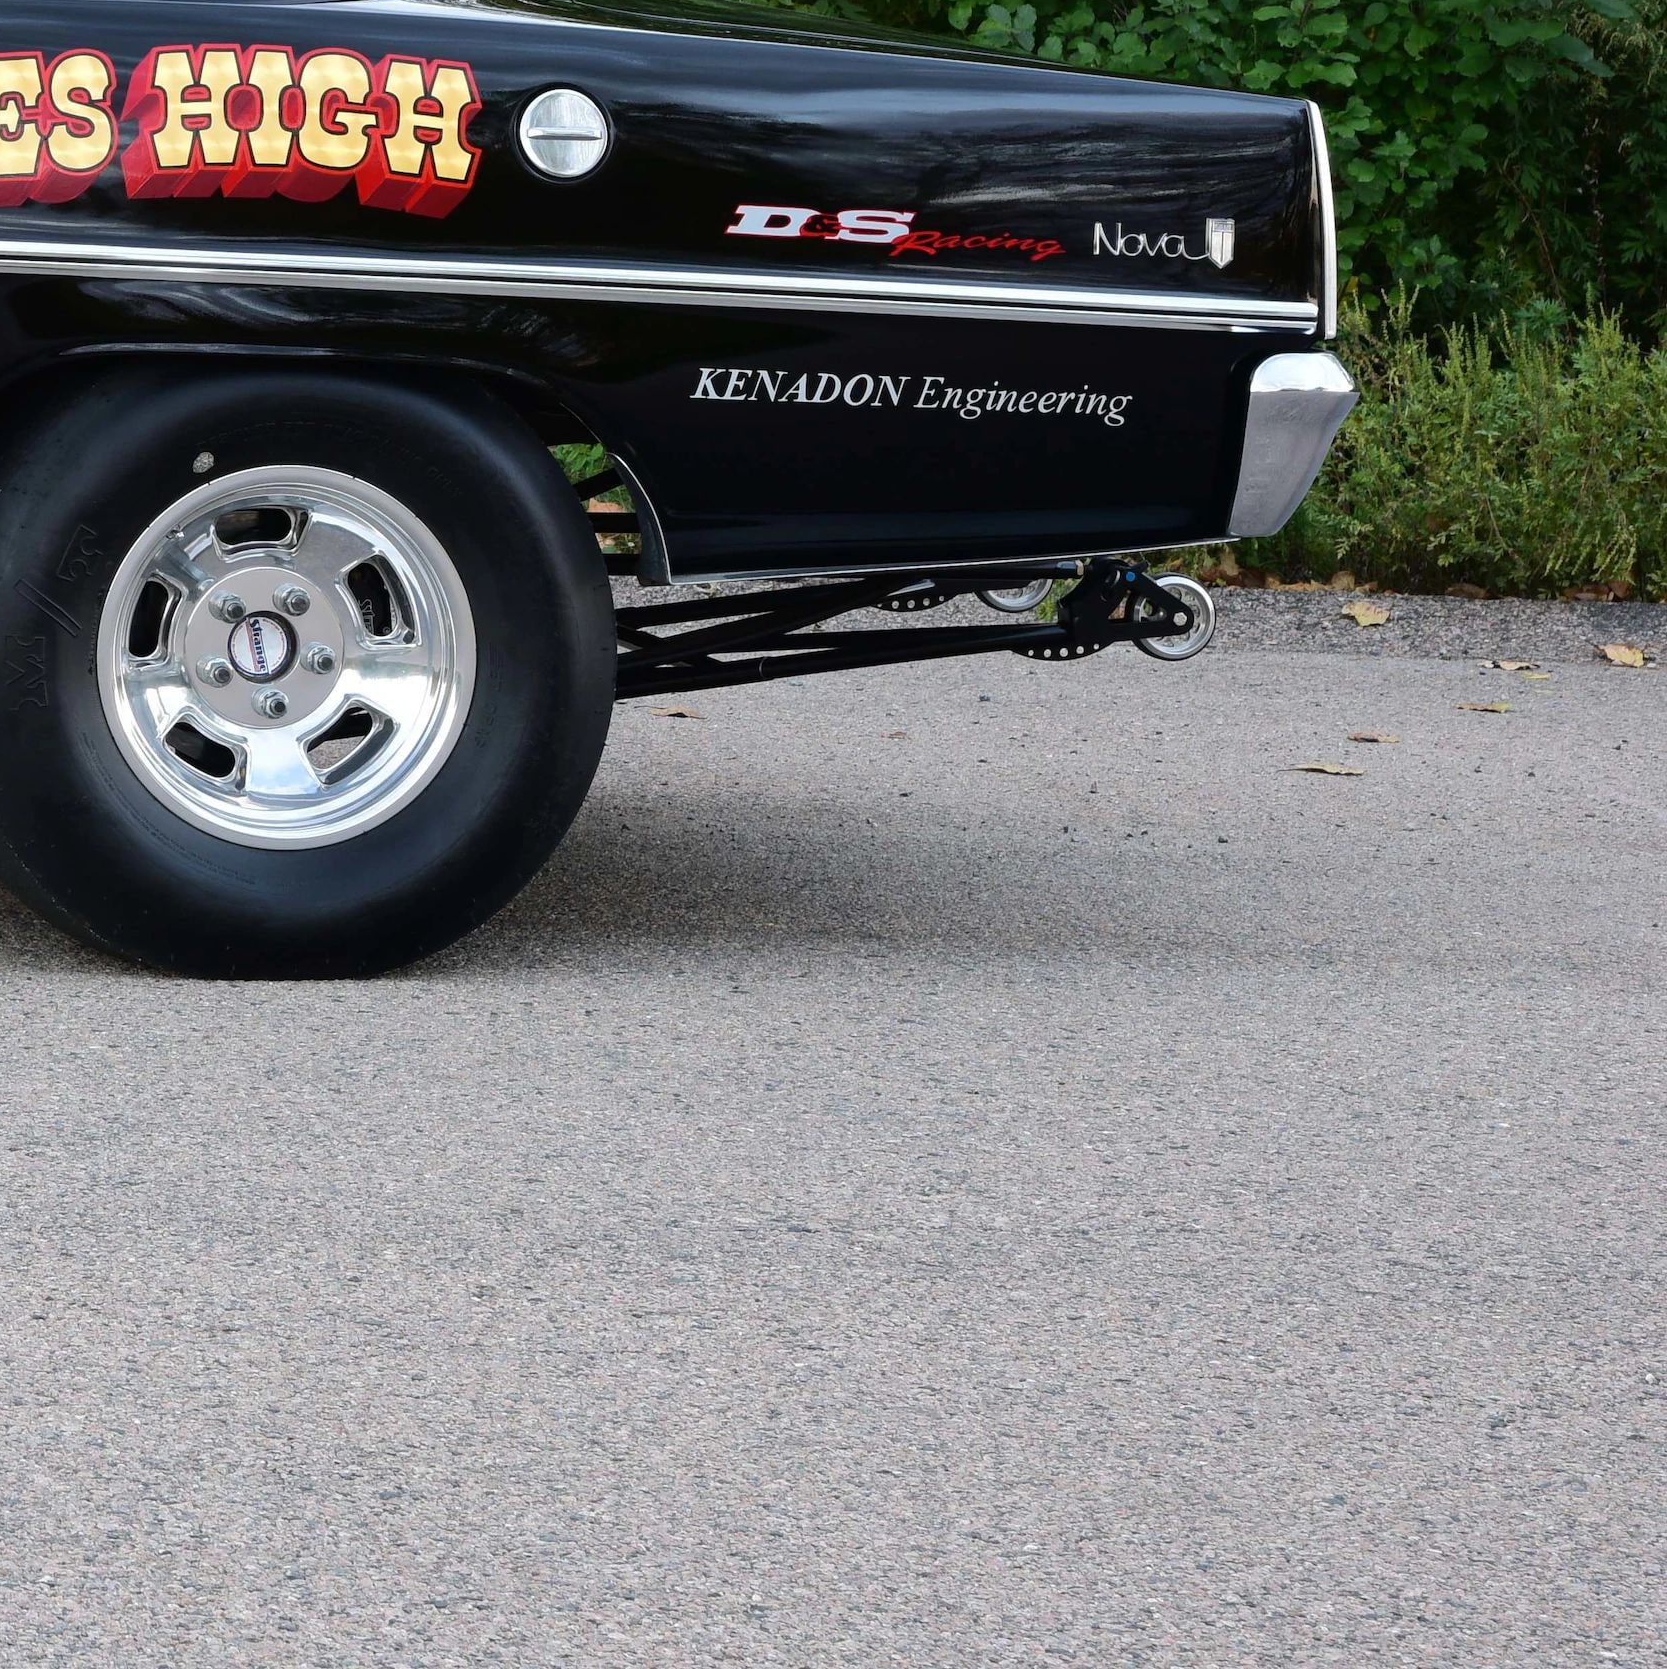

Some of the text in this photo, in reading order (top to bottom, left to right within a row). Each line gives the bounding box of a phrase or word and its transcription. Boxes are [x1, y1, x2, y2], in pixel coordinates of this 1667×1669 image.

[120, 43, 482, 217] HIGH
[889, 230, 1067, 262] Racing
[1093, 221, 1209, 260] Nova
[690, 367, 1133, 427] KENADON Engineering
[249, 618, 267, 673] Strange
